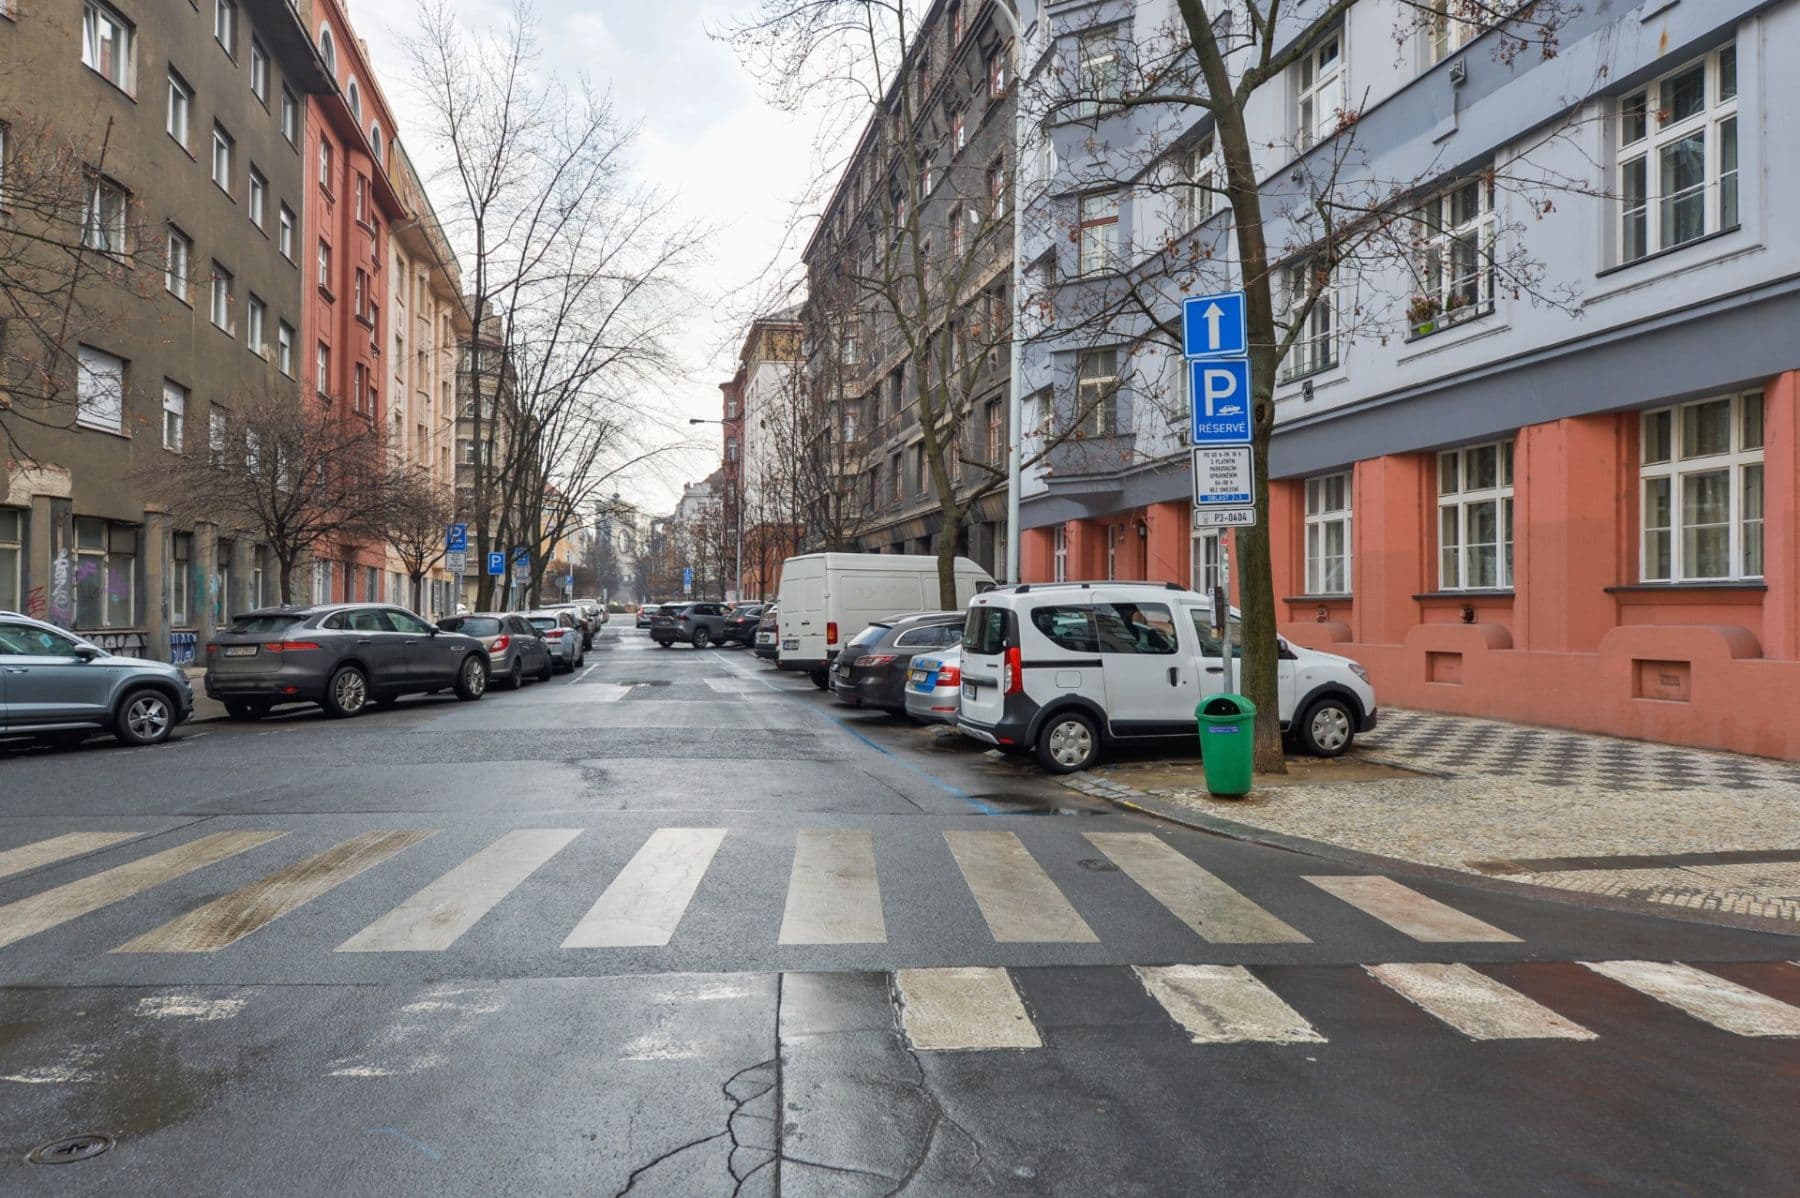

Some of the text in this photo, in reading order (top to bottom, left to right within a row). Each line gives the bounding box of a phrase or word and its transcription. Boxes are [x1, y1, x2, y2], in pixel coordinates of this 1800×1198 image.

[1204, 369, 1237, 416] P
[1199, 421, 1246, 433] RÉSERVÉ
[1214, 512, 1248, 523] P3-0404
[491, 554, 502, 569] P
